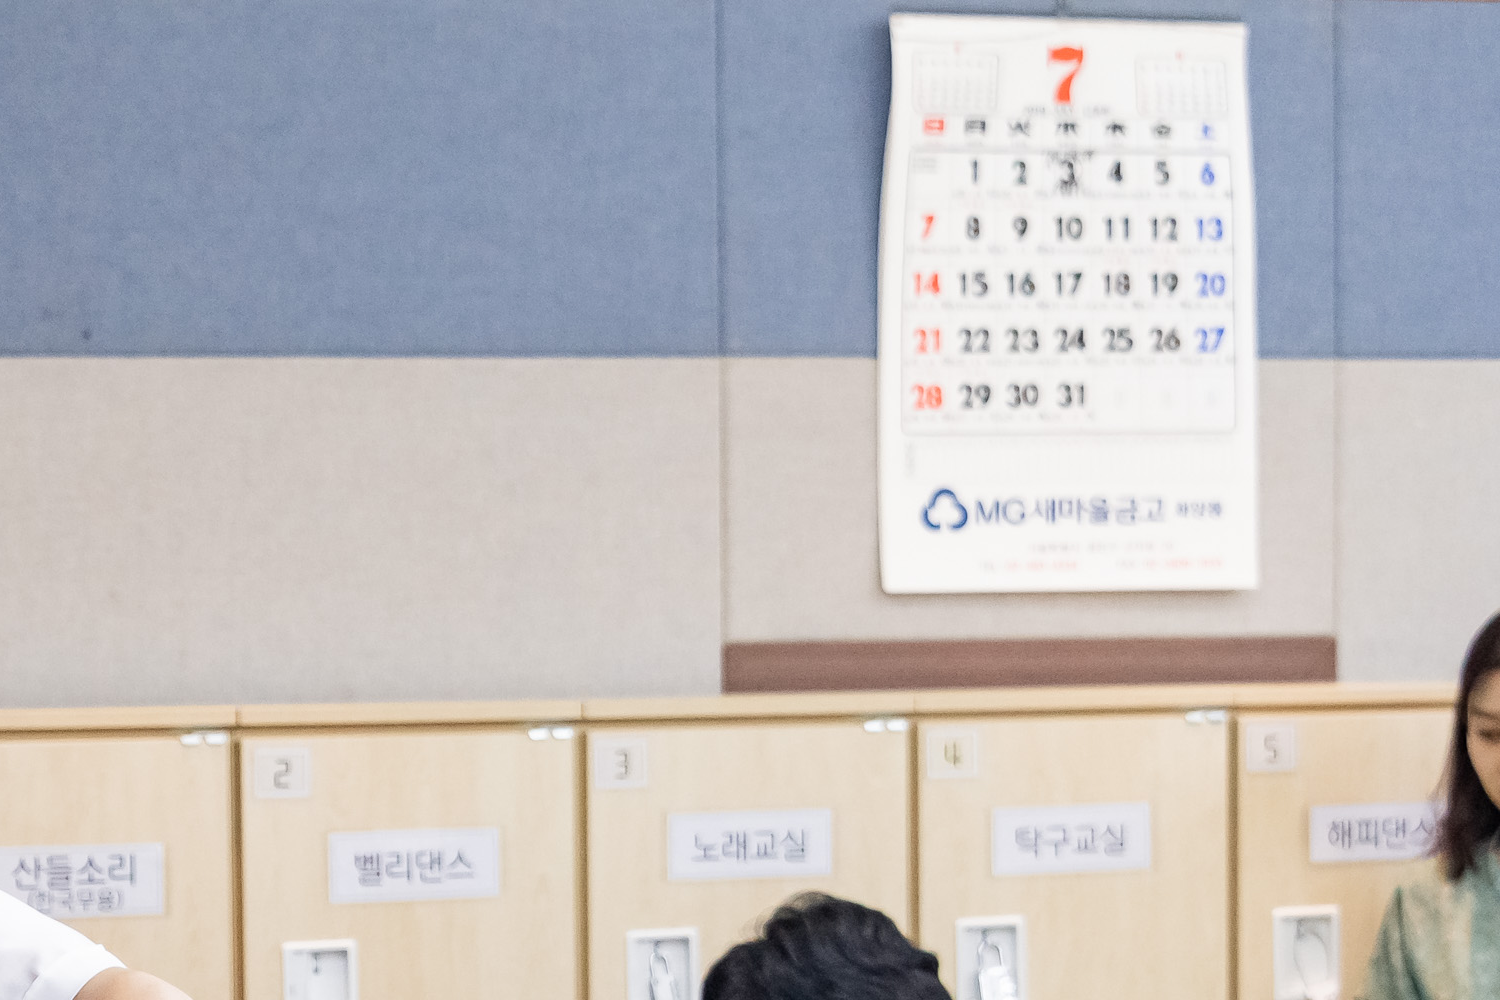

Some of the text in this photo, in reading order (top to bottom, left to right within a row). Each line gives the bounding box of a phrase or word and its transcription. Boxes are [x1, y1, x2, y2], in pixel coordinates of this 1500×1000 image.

[1048, 45, 1085, 105] 7
[968, 157, 981, 185] 1
[1011, 158, 1029, 187] 2
[1107, 159, 1125, 184] 4
[1152, 158, 1172, 187] 5
[1198, 161, 1217, 187] 6
[921, 212, 1225, 243] 7 8 9 10 11 12 13
[912, 270, 1228, 299] 14 15 16 17 18 19 20
[913, 326, 1227, 355] 21 22 23 24 25 26 27
[911, 383, 945, 410] 28
[958, 382, 993, 410] 29
[1006, 382, 1040, 410] 30
[1057, 382, 1086, 409] 31
[973, 497, 1164, 526] MG새마을금고
[944, 743, 961, 766] 4
[1263, 735, 1279, 764] 5
[273, 759, 292, 790] 2
[614, 749, 632, 782] 3
[694, 829, 807, 863] 노래교실
[1014, 824, 1127, 857] 탁구교실
[12, 853, 137, 894] 산들소리
[353, 850, 473, 887] 벨리댄스
